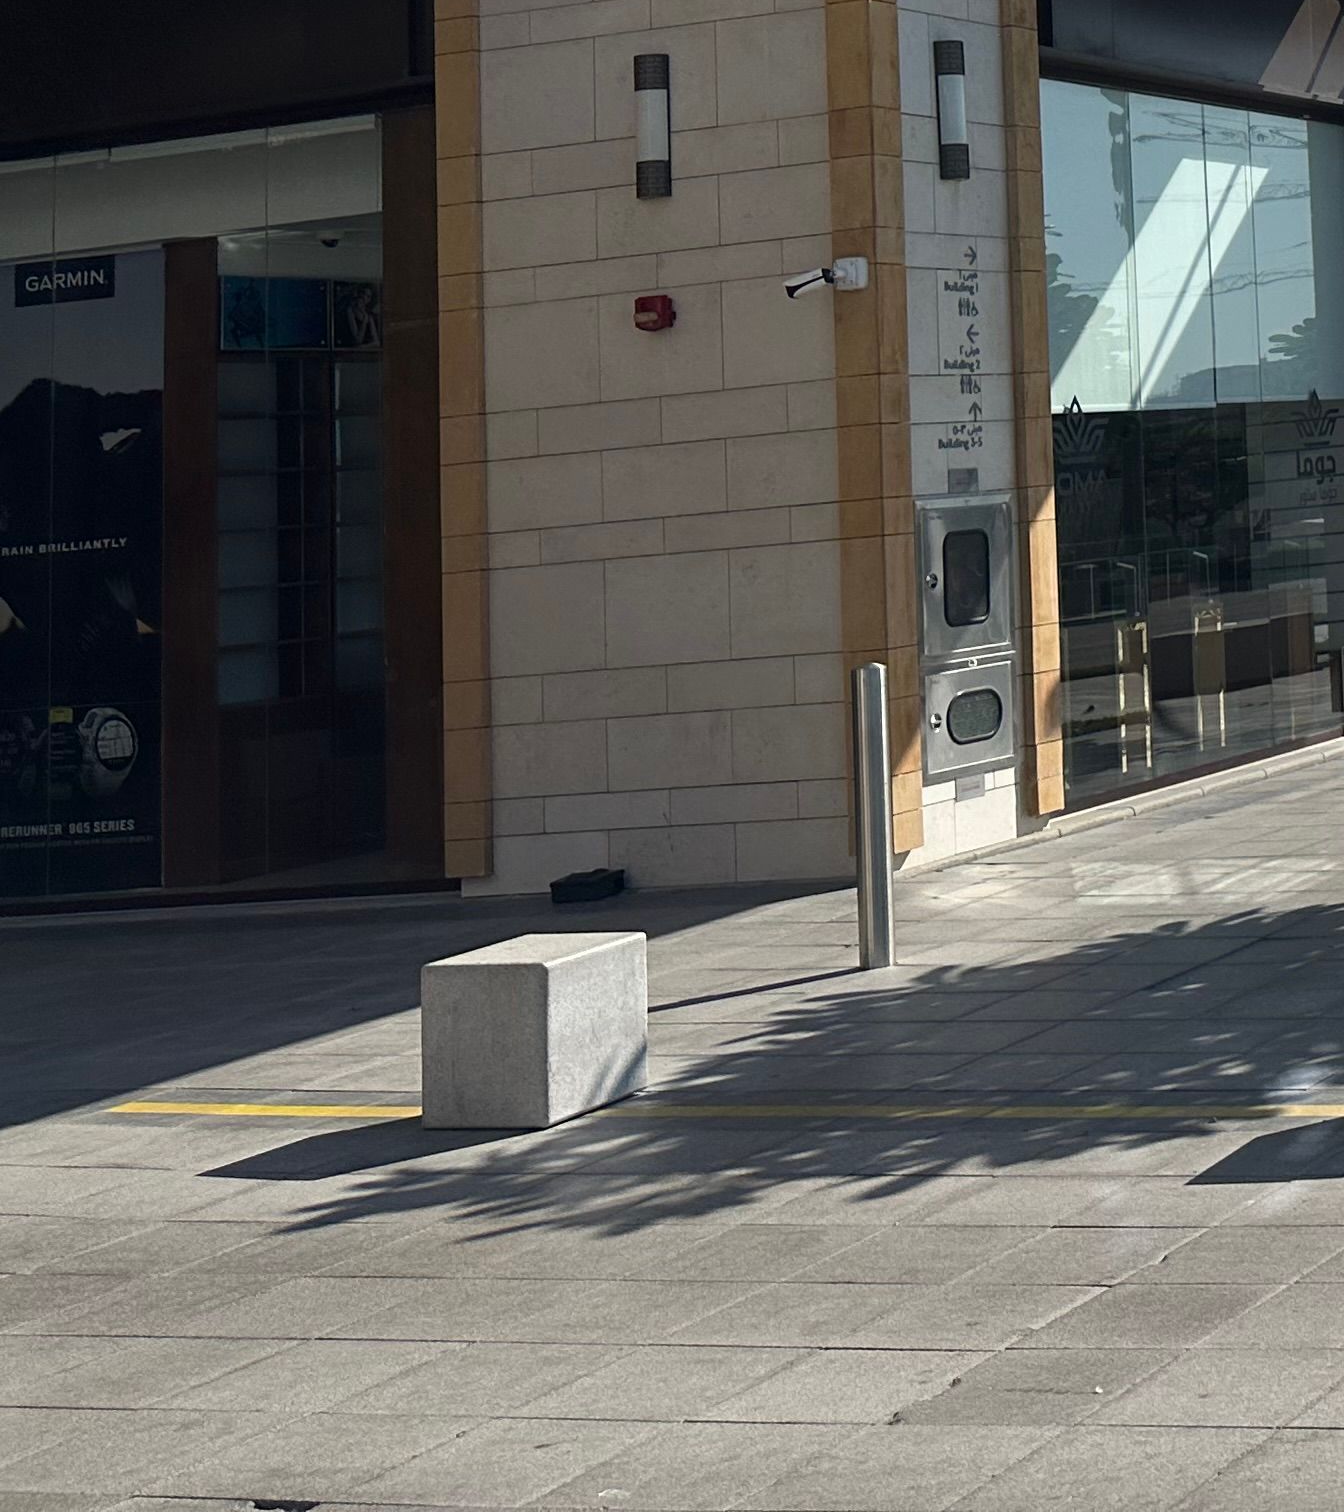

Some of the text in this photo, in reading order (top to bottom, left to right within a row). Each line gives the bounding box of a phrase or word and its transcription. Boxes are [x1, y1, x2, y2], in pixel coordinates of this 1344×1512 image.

[25, 268, 105, 292] GARMIN
[944, 281, 975, 295] Building
[944, 359, 981, 373] Building 2
[938, 436, 983, 451] Building 3-5
[1296, 451, 1337, 485] جوما
[38, 537, 128, 554] BRILLIANTLY
[93, 819, 136, 832] SERIES
